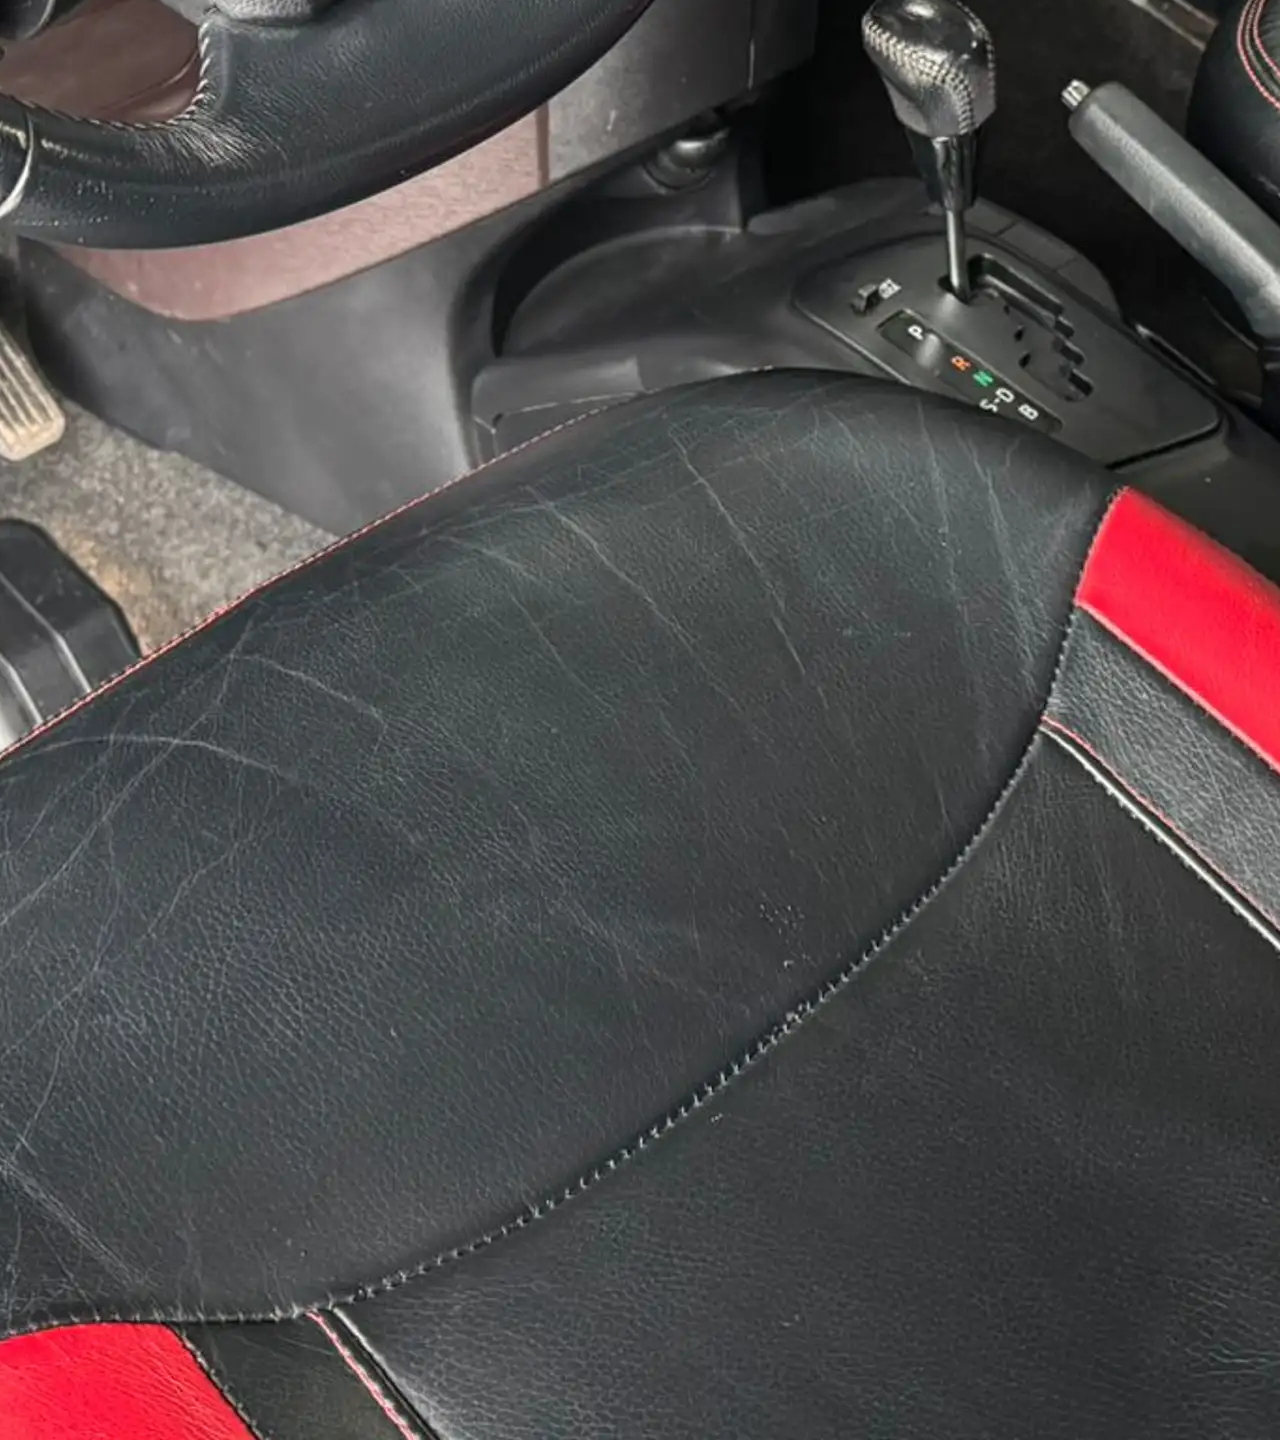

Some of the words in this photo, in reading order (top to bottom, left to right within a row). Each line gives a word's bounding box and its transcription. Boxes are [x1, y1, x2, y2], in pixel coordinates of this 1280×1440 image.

[907, 324, 924, 341] P
[951, 355, 971, 371] R
[972, 370, 994, 387] N
[1018, 403, 1039, 421] B
